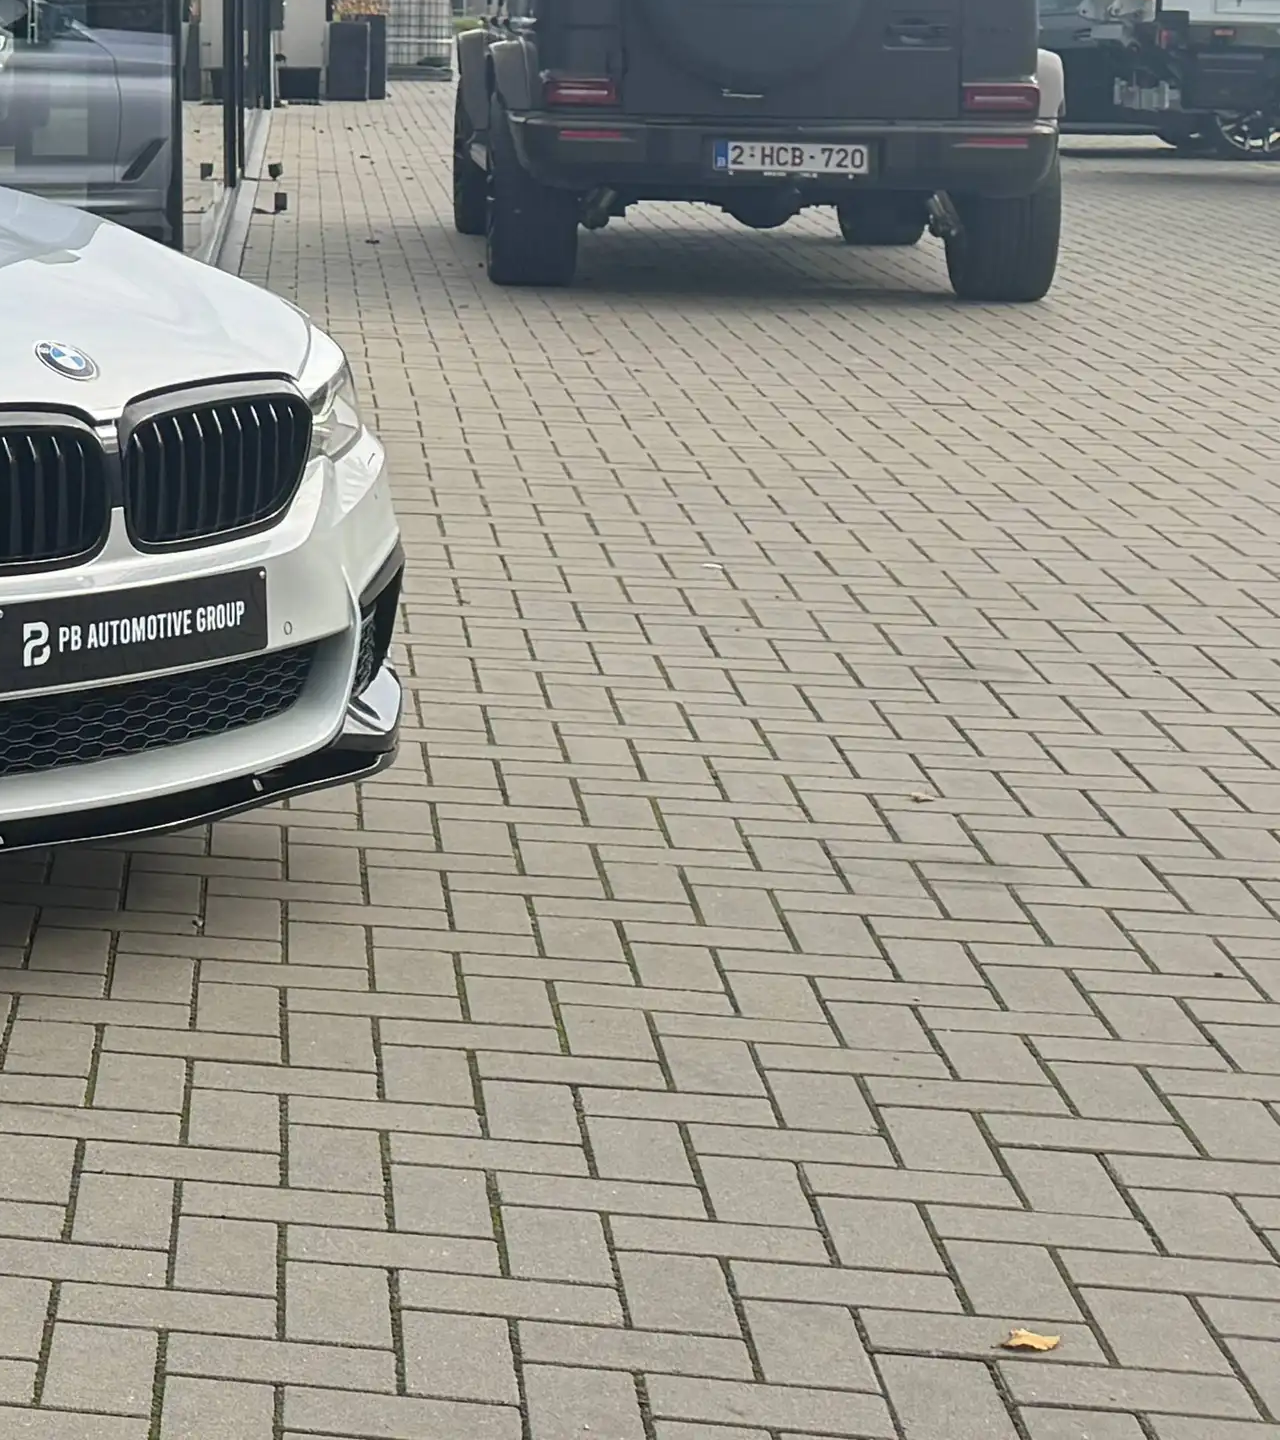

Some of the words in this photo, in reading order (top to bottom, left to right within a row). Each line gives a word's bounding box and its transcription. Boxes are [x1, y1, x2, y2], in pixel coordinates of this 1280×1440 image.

[58, 625, 82, 652] PB
[87, 609, 192, 649] AUTOMOTIVE
[196, 600, 245, 633] GROUP
